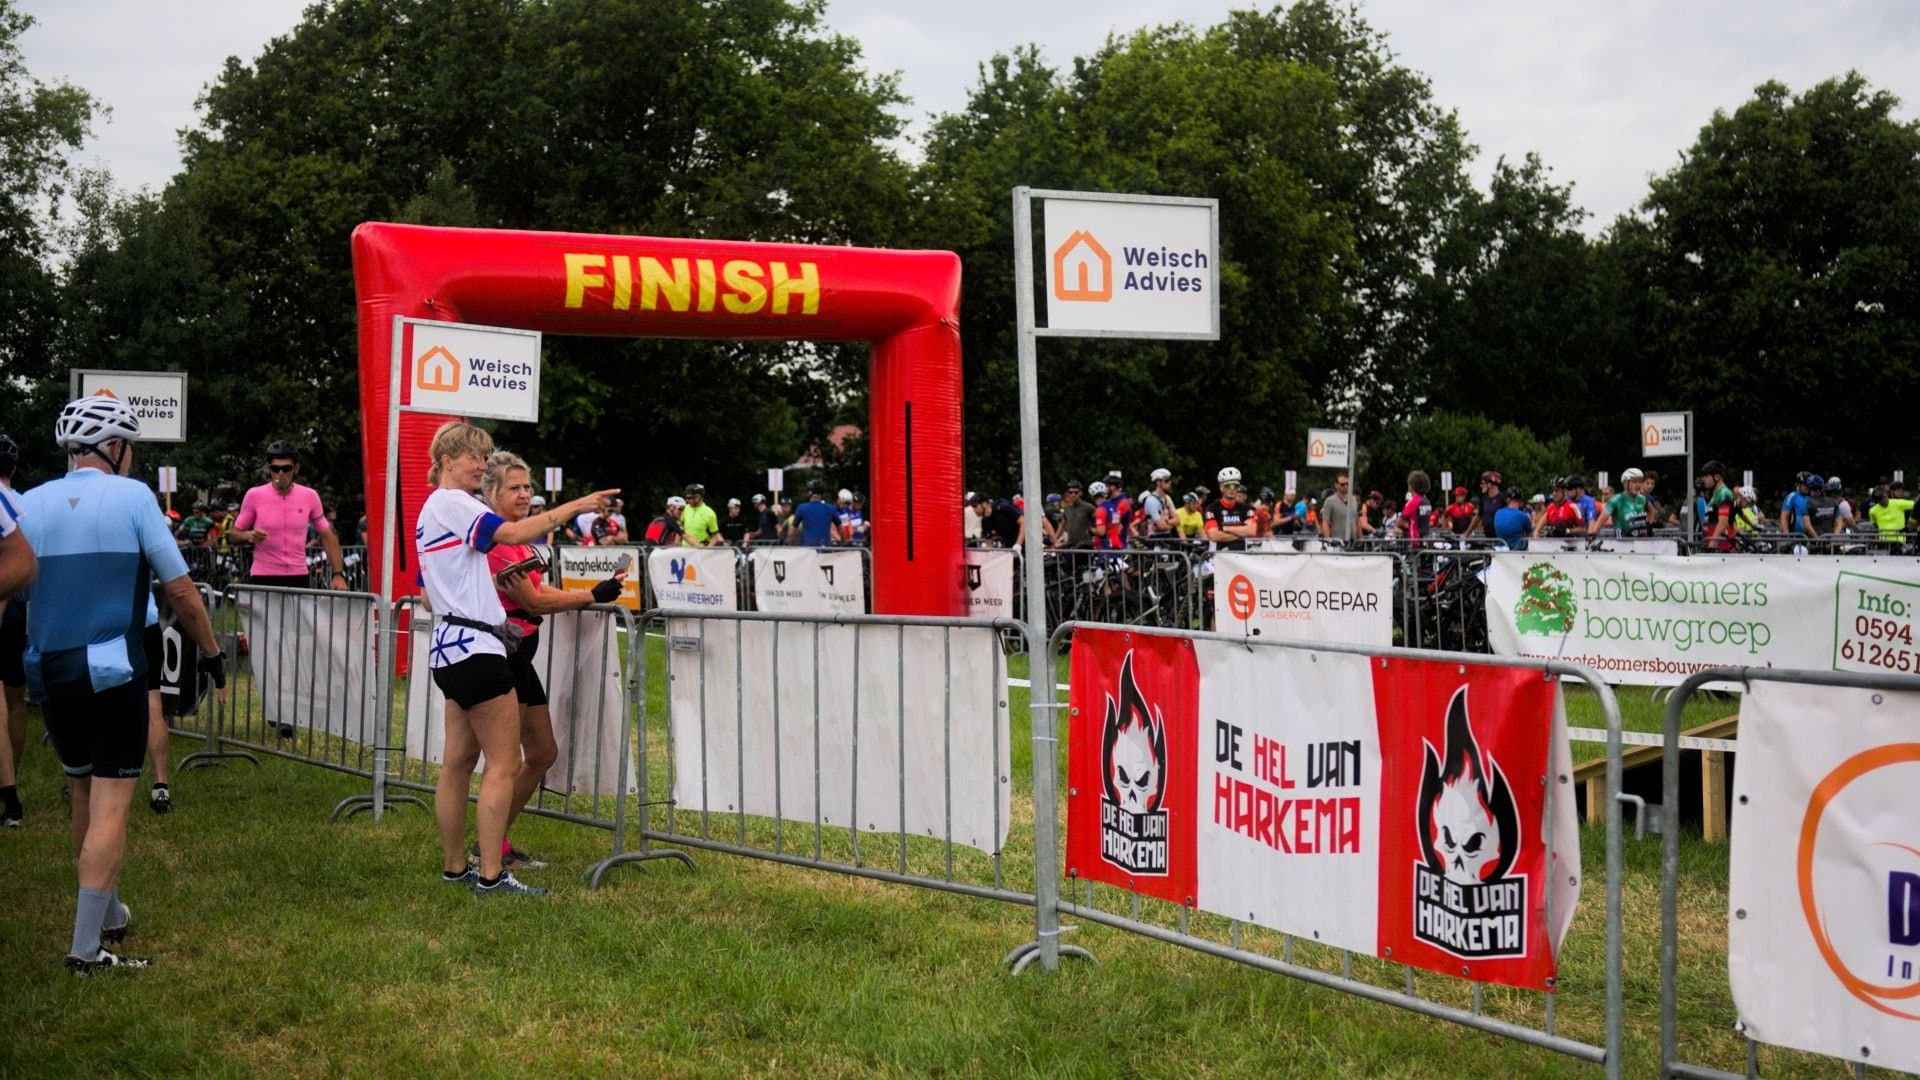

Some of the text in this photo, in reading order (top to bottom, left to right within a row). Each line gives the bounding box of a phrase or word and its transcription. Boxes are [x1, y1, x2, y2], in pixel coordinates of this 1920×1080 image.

[1123, 246, 1207, 268] Weisch
[564, 253, 820, 315] FINISH
[1124, 271, 1202, 292] Advies
[468, 358, 532, 376] Weisch
[468, 374, 528, 391] Advies
[128, 396, 178, 407] Weisch
[1259, 590, 1379, 612] EURO REPAR
[1583, 571, 1768, 606] notebomers
[1857, 588, 1911, 618] Info:
[1584, 609, 1771, 653] bouwgroep
[1855, 615, 1912, 645] 0594
[1216, 718, 1361, 790] DE HEL VAN
[1103, 802, 1165, 838] DE HEL VAN
[1214, 771, 1361, 854] HARKEMA
[1103, 826, 1166, 868] HARKEMA
[1419, 869, 1520, 914] DE HEL VAN
[1419, 899, 1520, 951] HARKEMA
